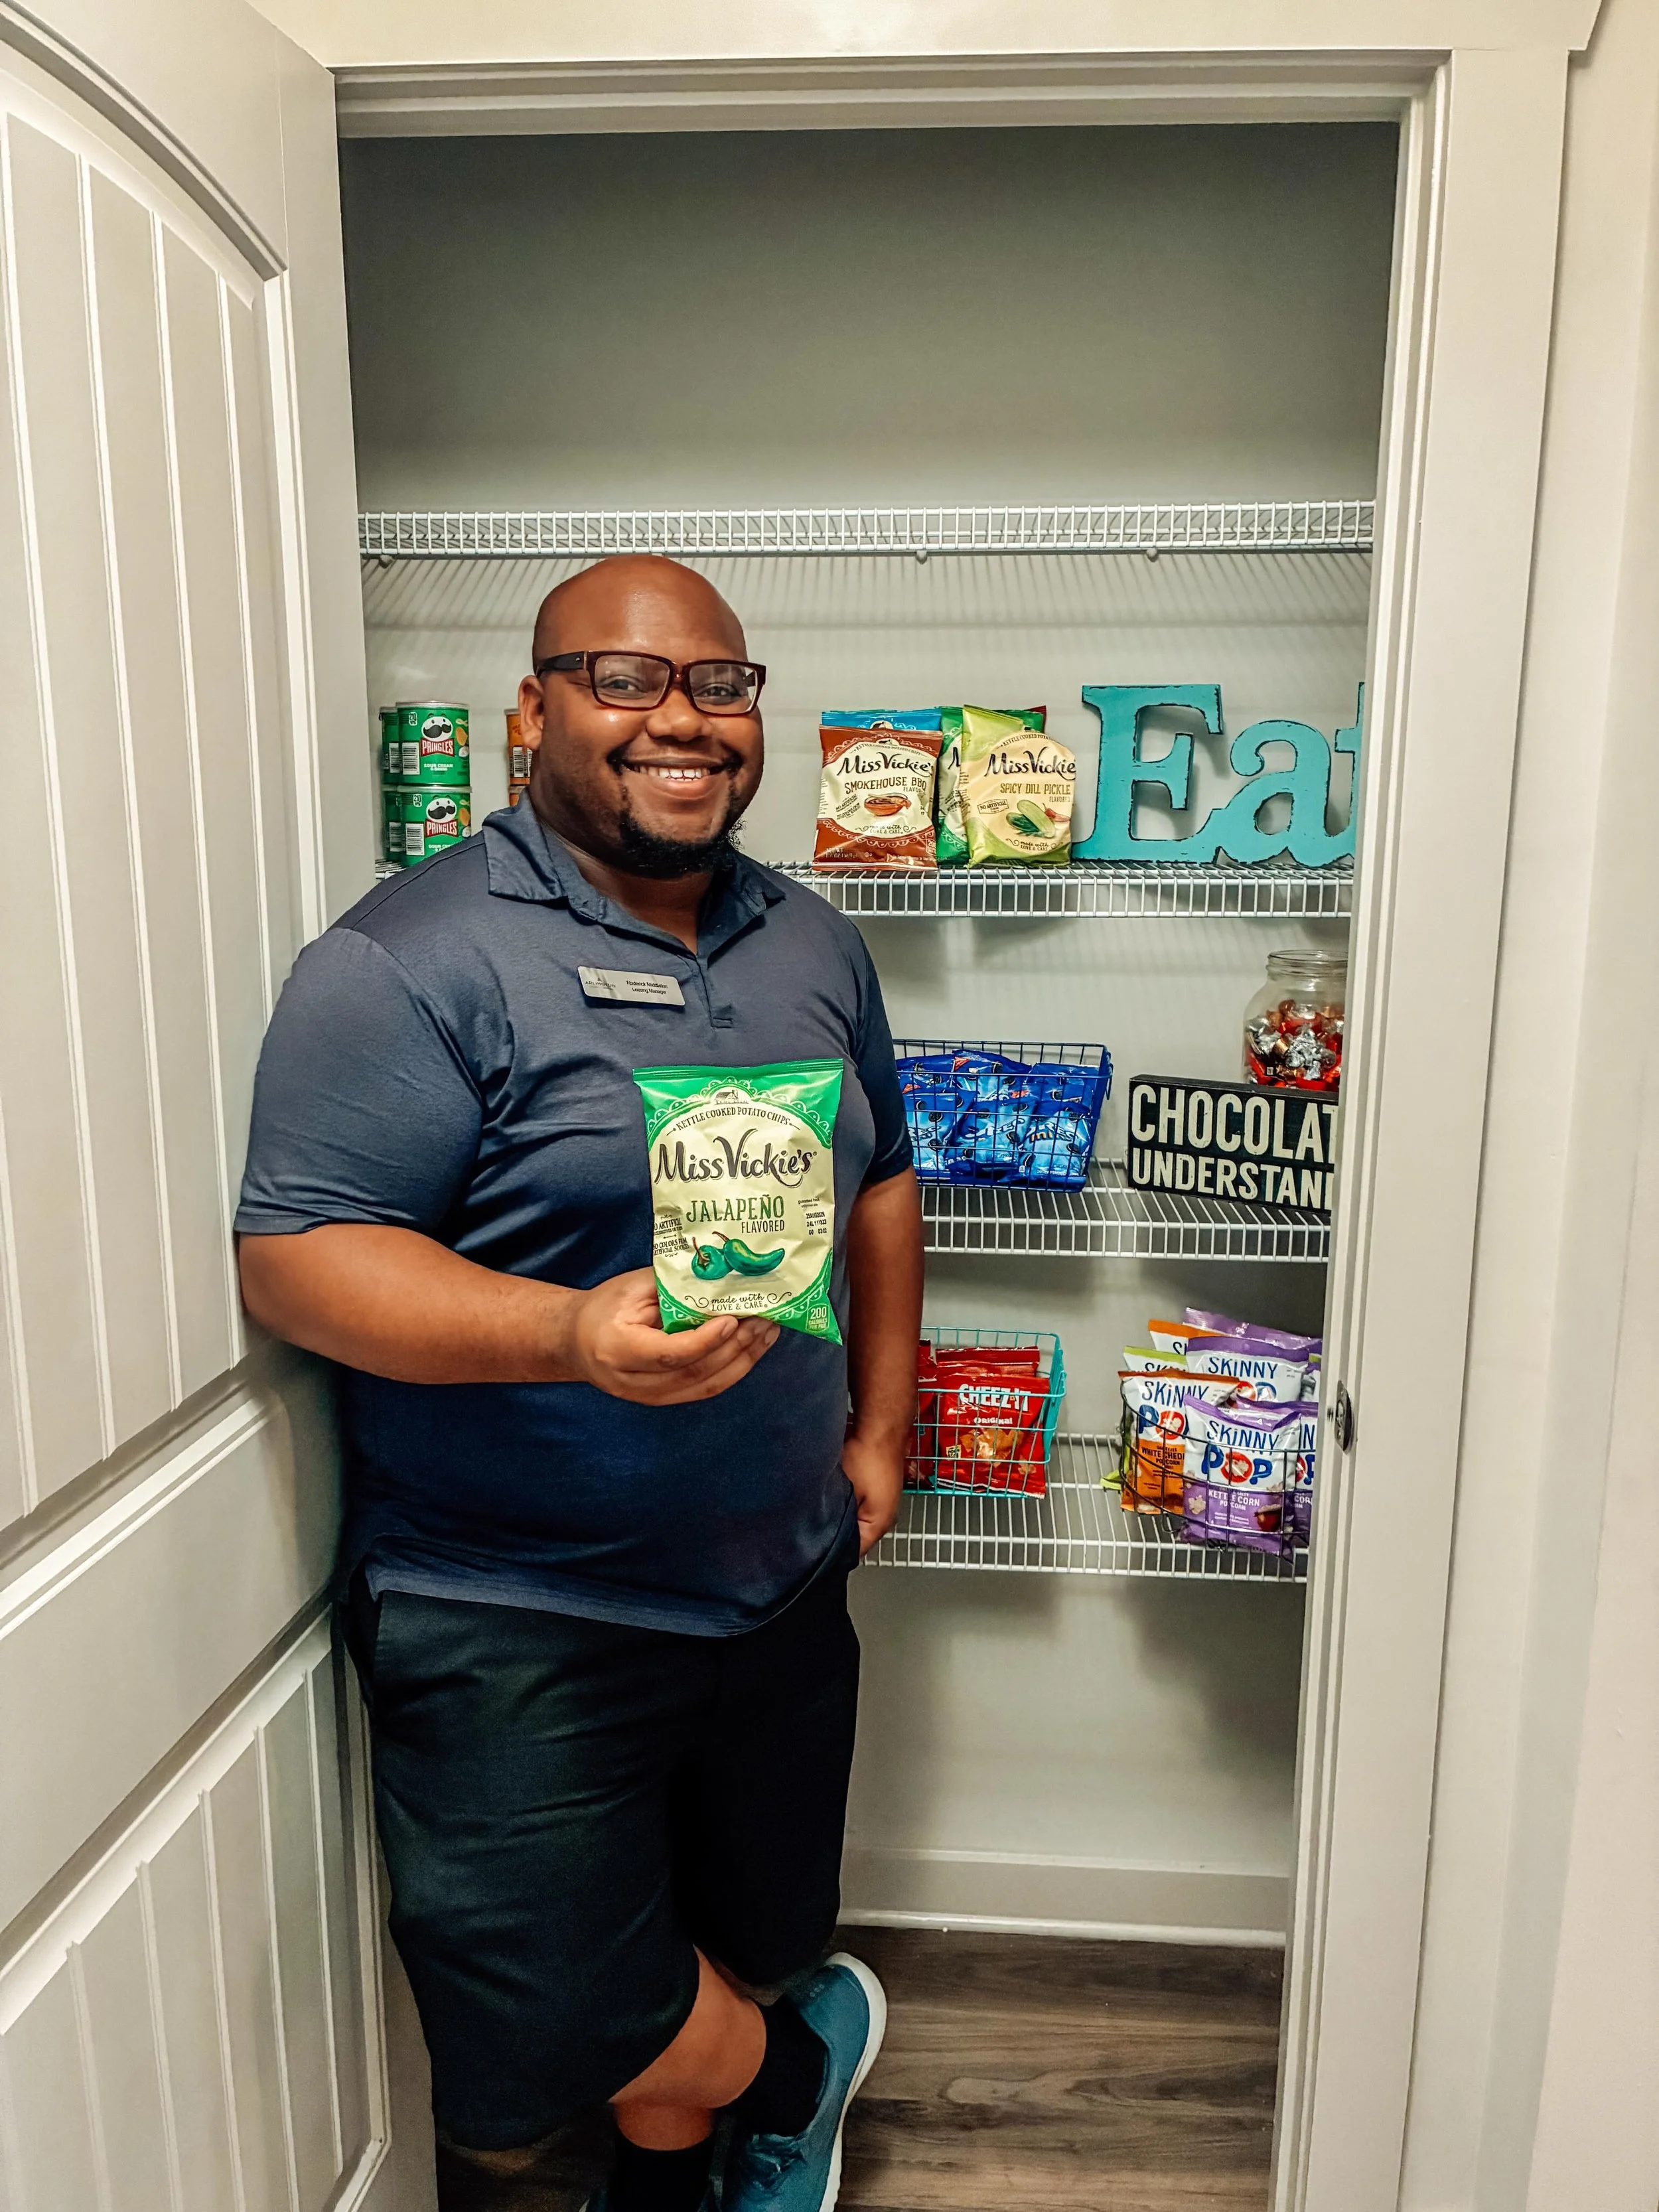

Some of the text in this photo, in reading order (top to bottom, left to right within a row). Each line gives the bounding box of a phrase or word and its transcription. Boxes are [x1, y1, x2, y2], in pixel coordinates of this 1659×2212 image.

[422, 740, 454, 755] PRINGLES
[837, 755, 881, 776] Miss
[984, 753, 1029, 777] Miss
[844, 776, 927, 794] SMOKEHOUSE BBQ
[1000, 782, 1071, 795] SPICY DILL PICKLE
[427, 820, 457, 836] PRINGLES
[676, 1106, 790, 1131] KETTLE COOKED POTATO CHIPS
[654, 1128, 814, 1189] Miss Vickie's
[686, 1195, 784, 1222] JALAPEÑO
[741, 1220, 785, 1234] FLAVORED
[659, 1239, 678, 1248] COLORS
[711, 1293, 764, 1304] made with
[810, 1306, 827, 1319] 200
[1141, 1447, 1161, 1458] WHITE
[1201, 1443, 1273, 1485] POP
[1208, 1489, 1260, 1507] KETTE CORN
[1220, 1501, 1246, 1511] POCORN
